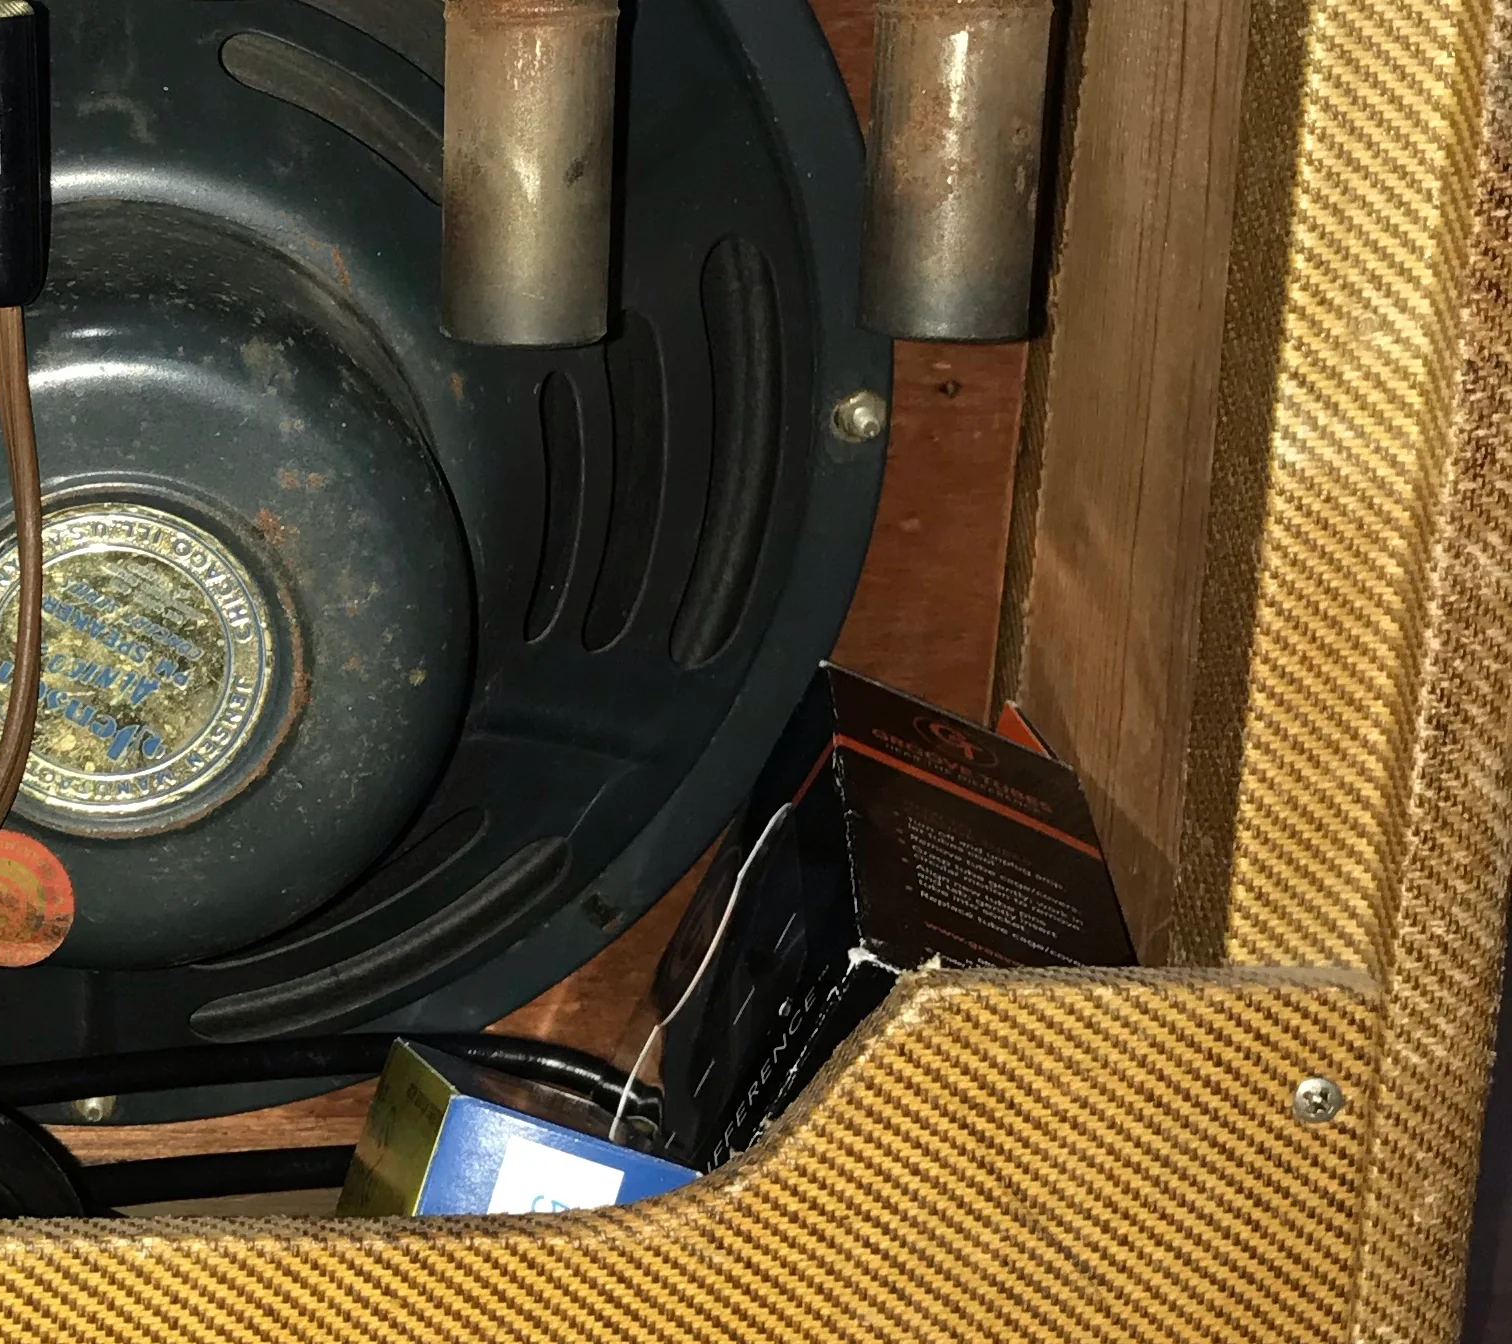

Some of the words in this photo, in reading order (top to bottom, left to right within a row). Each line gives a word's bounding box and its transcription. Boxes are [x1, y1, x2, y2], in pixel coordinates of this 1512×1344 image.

[171, 537, 254, 645] CHICAGO
[42, 594, 148, 662] SPEAKER
[49, 654, 156, 707] ALNICO
[157, 656, 189, 688] PM
[187, 678, 256, 772] JENSEN
